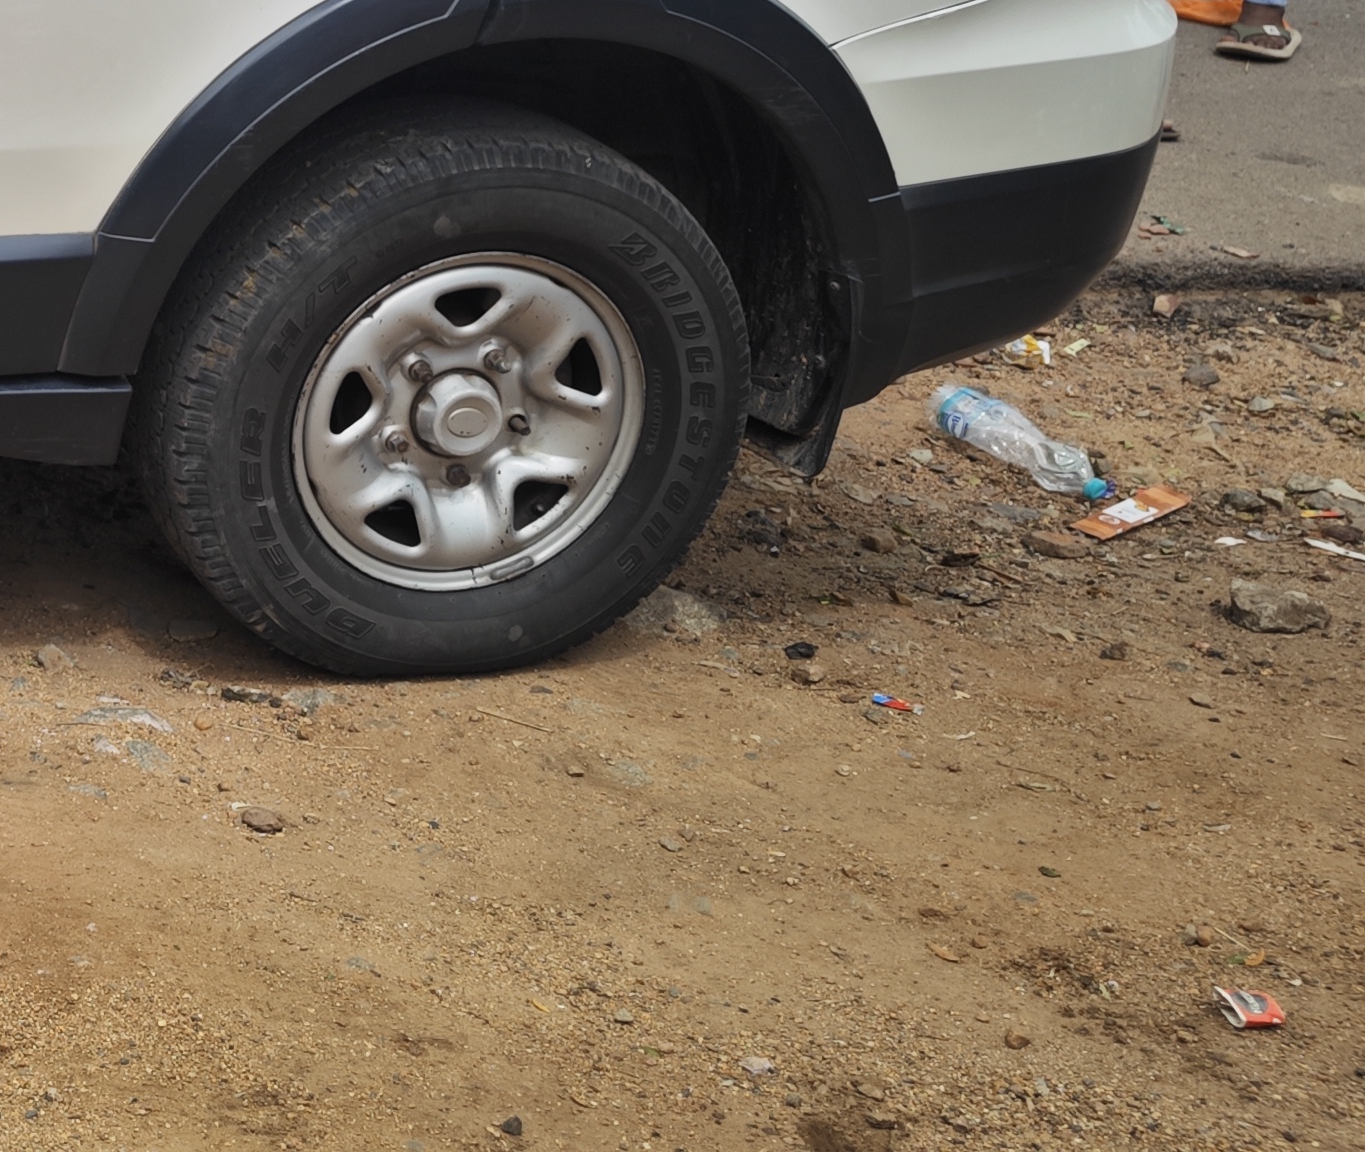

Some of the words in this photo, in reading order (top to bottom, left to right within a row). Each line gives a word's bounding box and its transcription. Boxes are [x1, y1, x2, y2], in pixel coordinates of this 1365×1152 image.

[265, 255, 358, 373] H/T
[607, 231, 717, 578] BRIDGESTONE
[239, 407, 377, 639] DUELER
